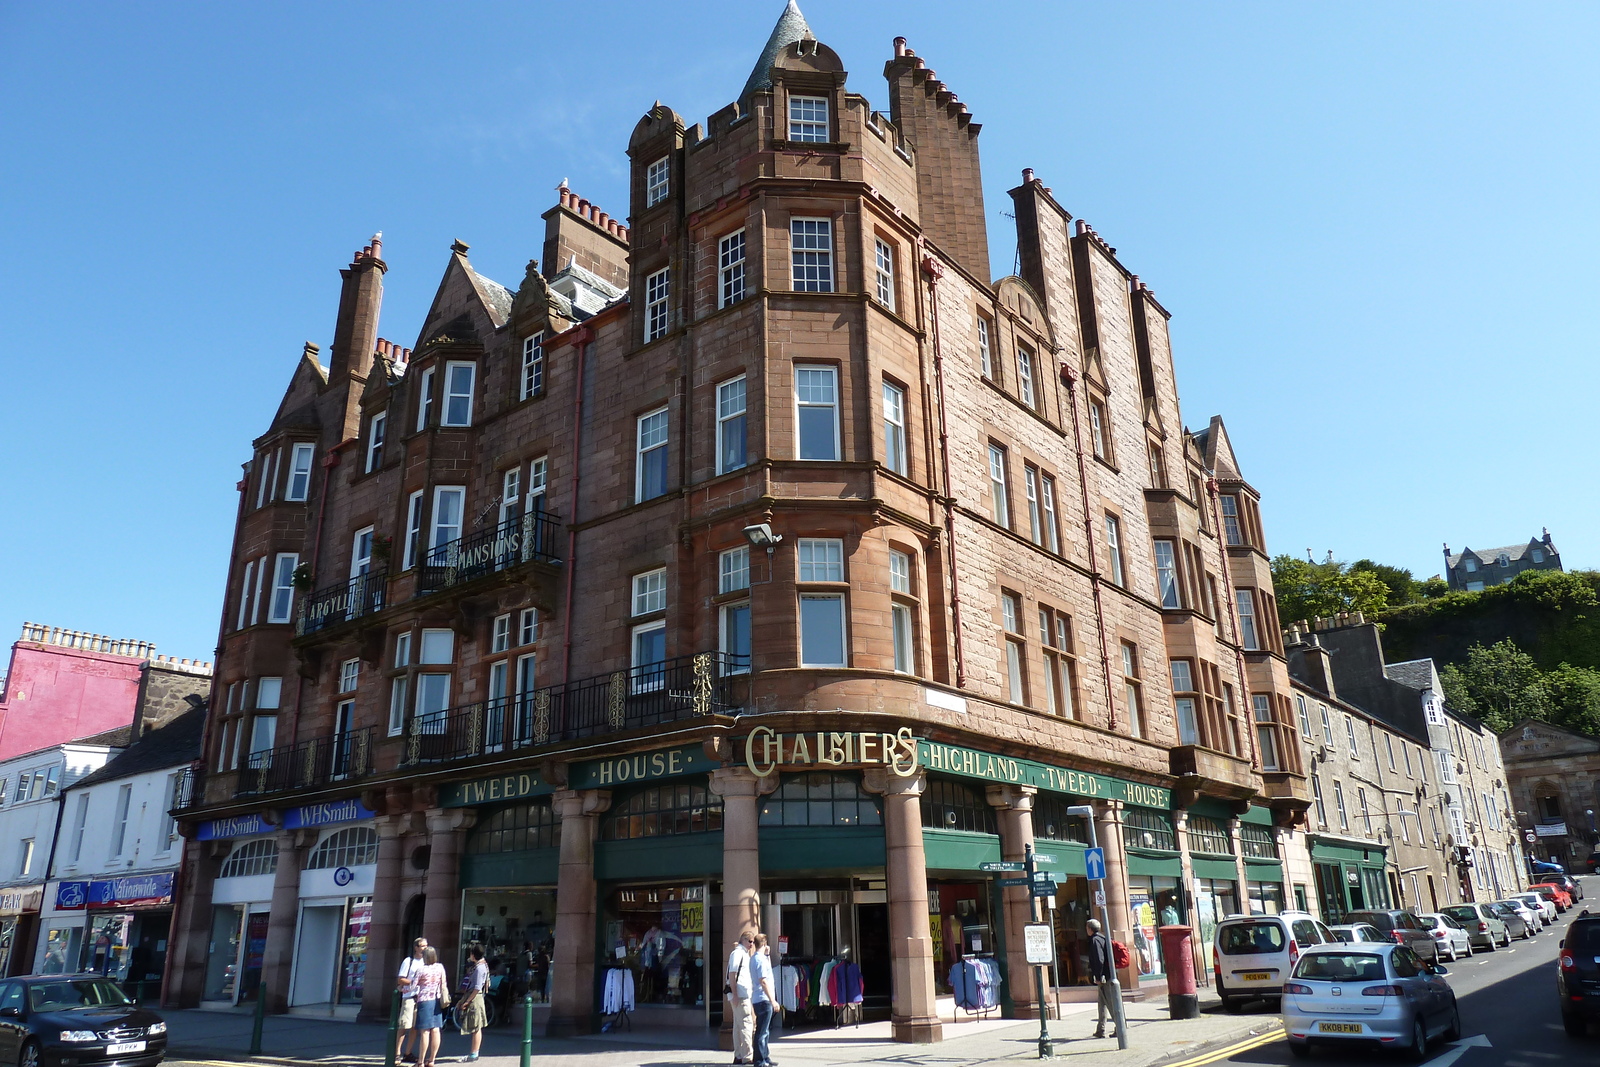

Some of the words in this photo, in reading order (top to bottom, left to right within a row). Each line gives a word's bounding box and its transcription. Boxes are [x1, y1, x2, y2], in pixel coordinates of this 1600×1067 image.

[457, 532, 520, 570] MANSIONS
[308, 592, 350, 620] ARGYLL
[745, 726, 918, 777] CHALMERS
[461, 773, 531, 804] TWEED
[598, 749, 684, 786] HOUSE
[929, 743, 1019, 781] HIGHLAND
[1045, 766, 1098, 796] TWEED
[1125, 782, 1166, 808] HOUSE
[211, 814, 260, 837] WHSmith
[301, 800, 358, 826] WHSmith
[112, 878, 157, 900] Nationwide
[1322, 1023, 1343, 1032] KK08
